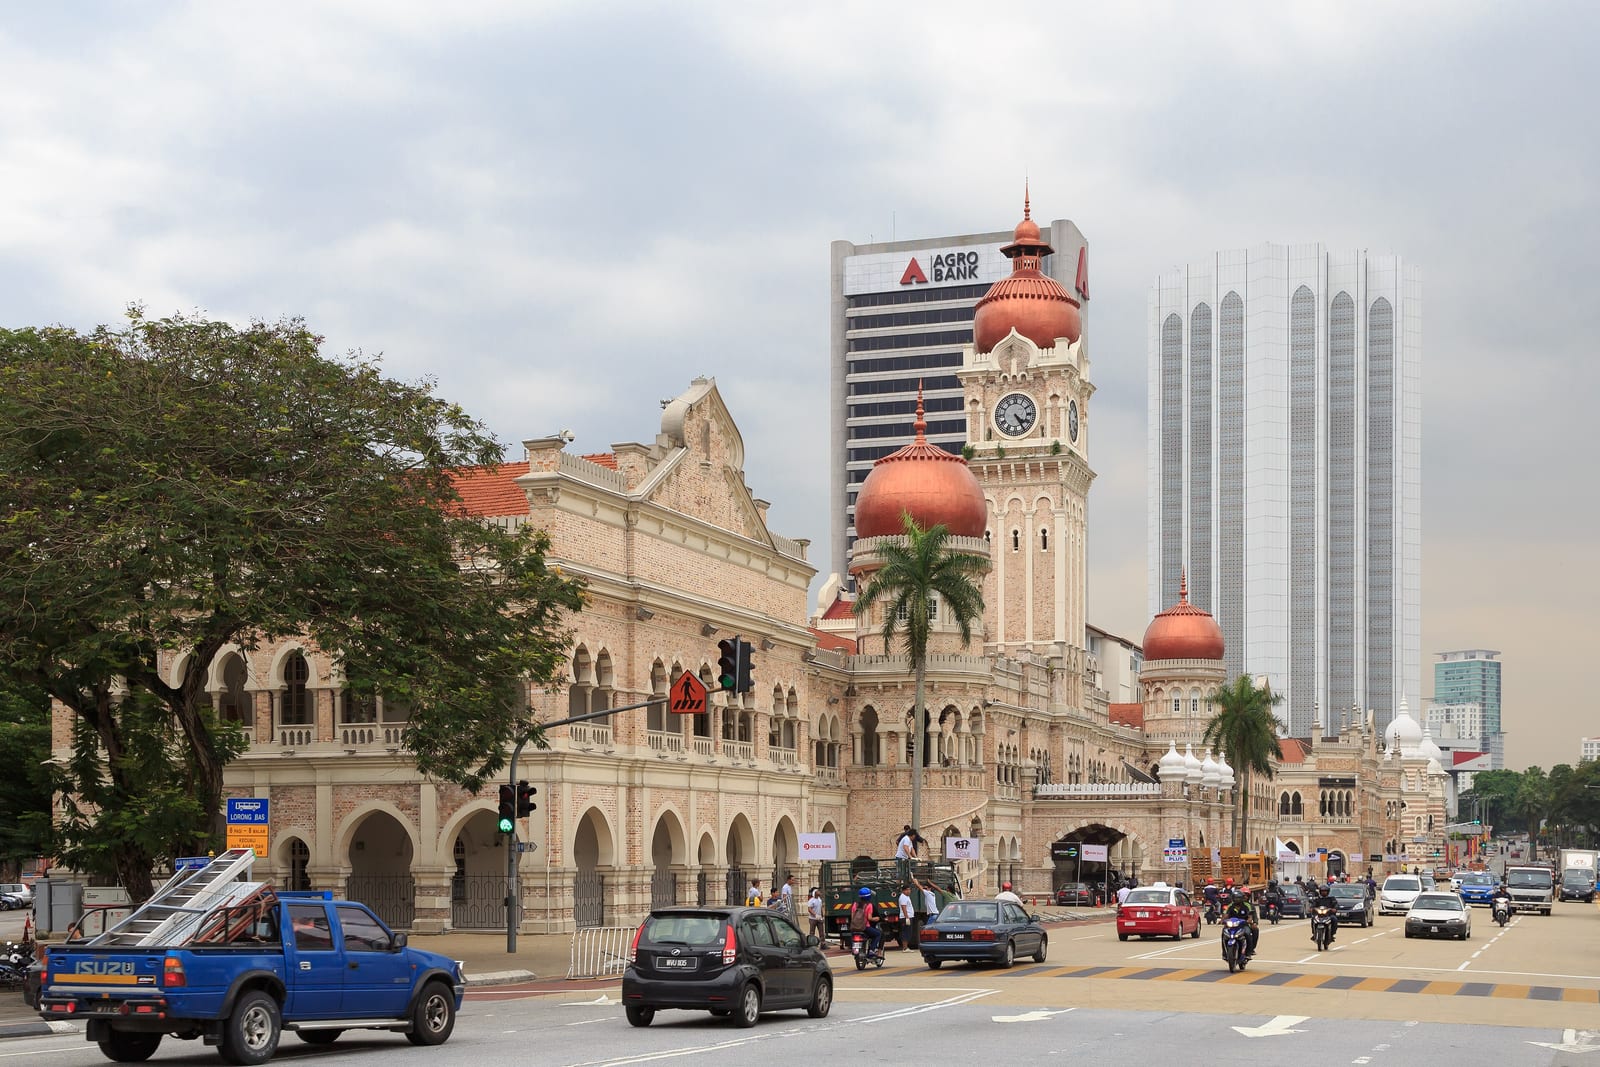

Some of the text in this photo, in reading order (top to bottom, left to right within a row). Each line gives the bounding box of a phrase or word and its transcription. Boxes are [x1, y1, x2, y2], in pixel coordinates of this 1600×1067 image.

[933, 251, 978, 268] AGRO
[934, 265, 978, 282] BANK
[76, 961, 135, 975] ISUZU
